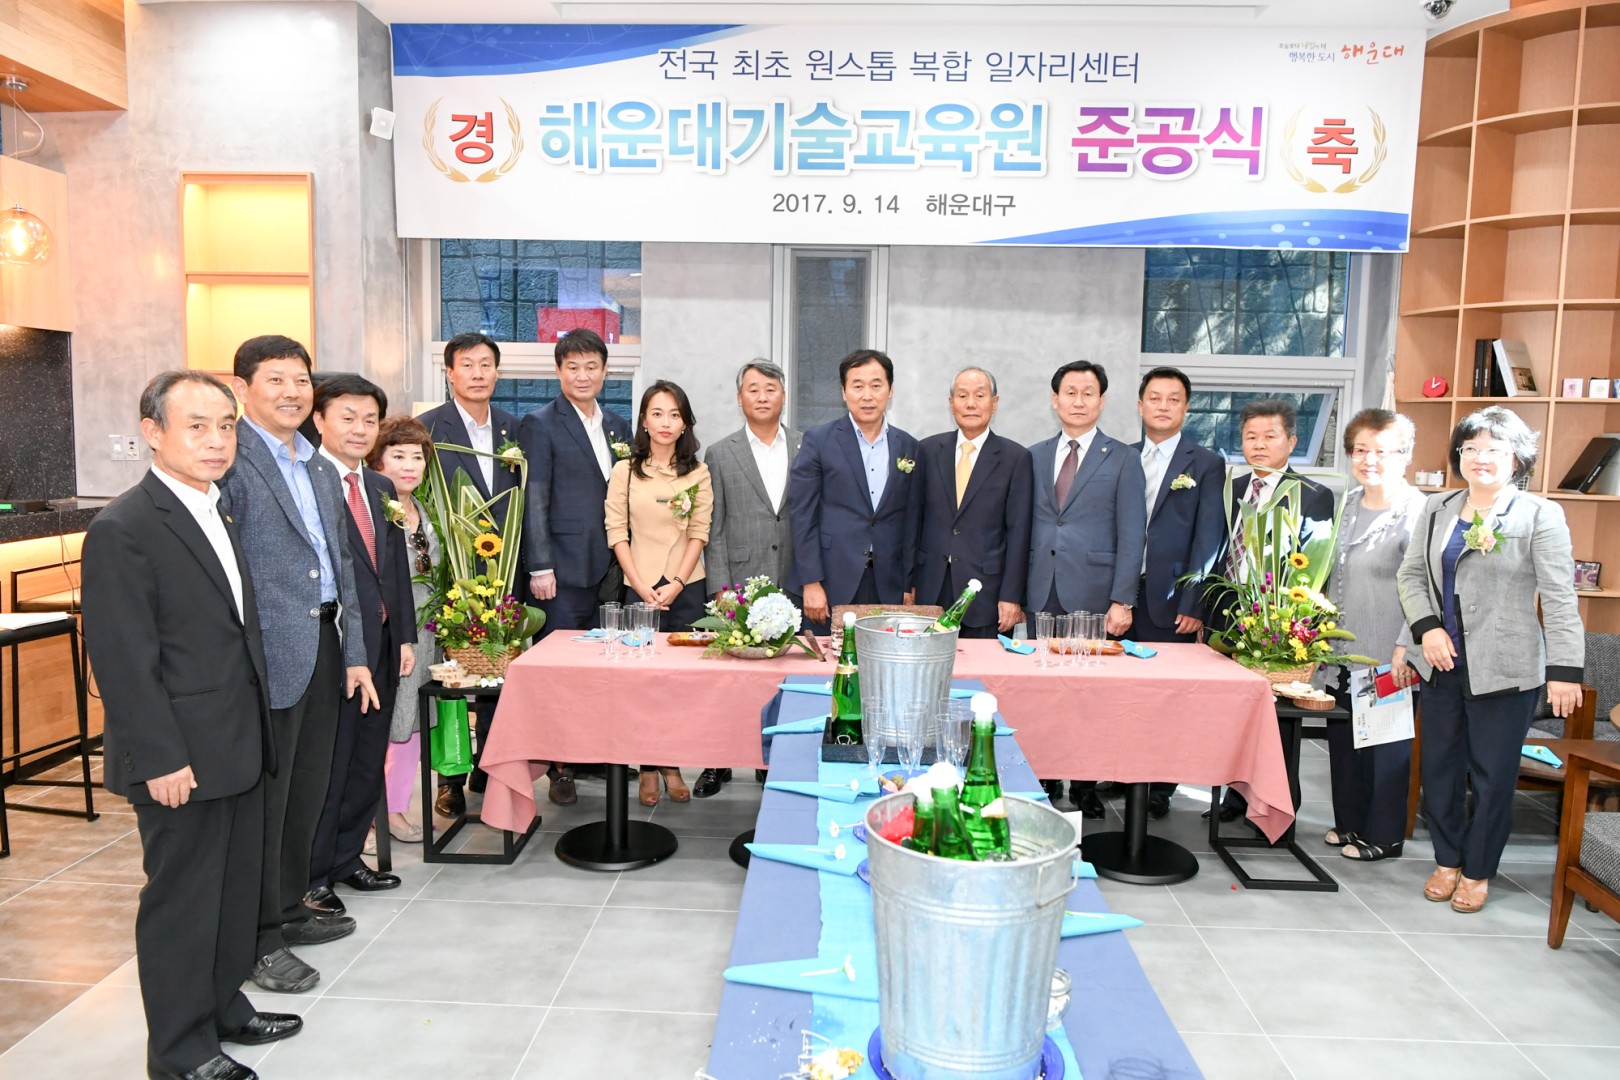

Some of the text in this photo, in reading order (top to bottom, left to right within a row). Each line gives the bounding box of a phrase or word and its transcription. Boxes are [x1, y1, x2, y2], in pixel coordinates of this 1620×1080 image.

[658, 49, 1140, 84] 전국 최초 원스톱 복합 일자리센터
[1288, 51, 1336, 63] 행복한 도시
[1340, 41, 1406, 65] 해운대
[449, 111, 494, 164] 경
[538, 101, 1264, 175] 해운대기술교육원 준공식
[1306, 118, 1359, 174] 축
[772, 193, 1016, 217] 2017. 9. 14 해운대구
